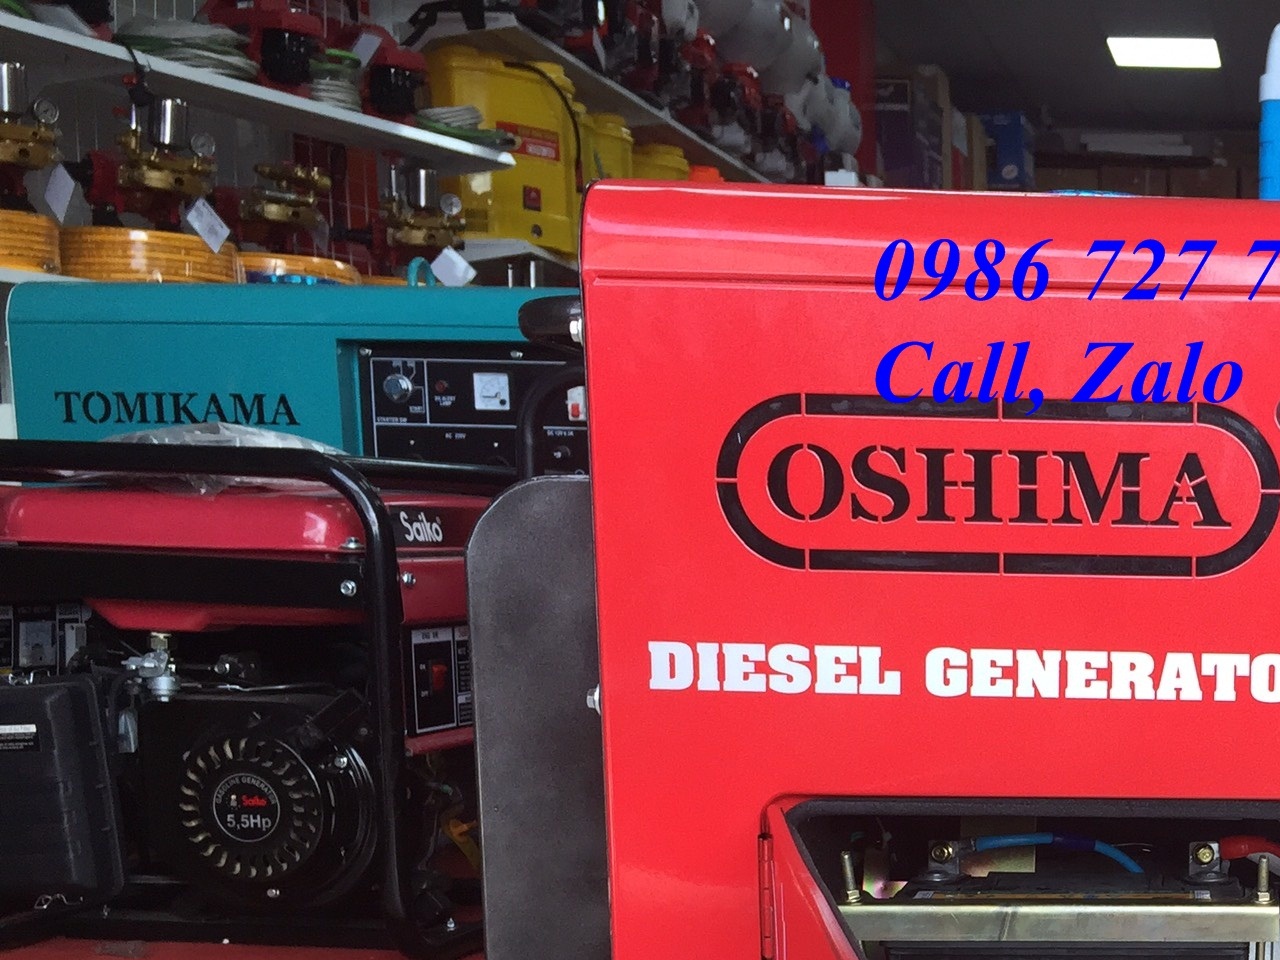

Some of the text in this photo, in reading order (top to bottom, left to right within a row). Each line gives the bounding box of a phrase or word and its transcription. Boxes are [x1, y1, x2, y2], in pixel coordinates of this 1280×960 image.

[54, 390, 300, 426] TOMIKAMA
[767, 442, 1232, 529] OSHIMA
[400, 511, 443, 543] Saiko
[648, 641, 902, 696] DIESEL
[226, 813, 272, 832] 5,5Hp
